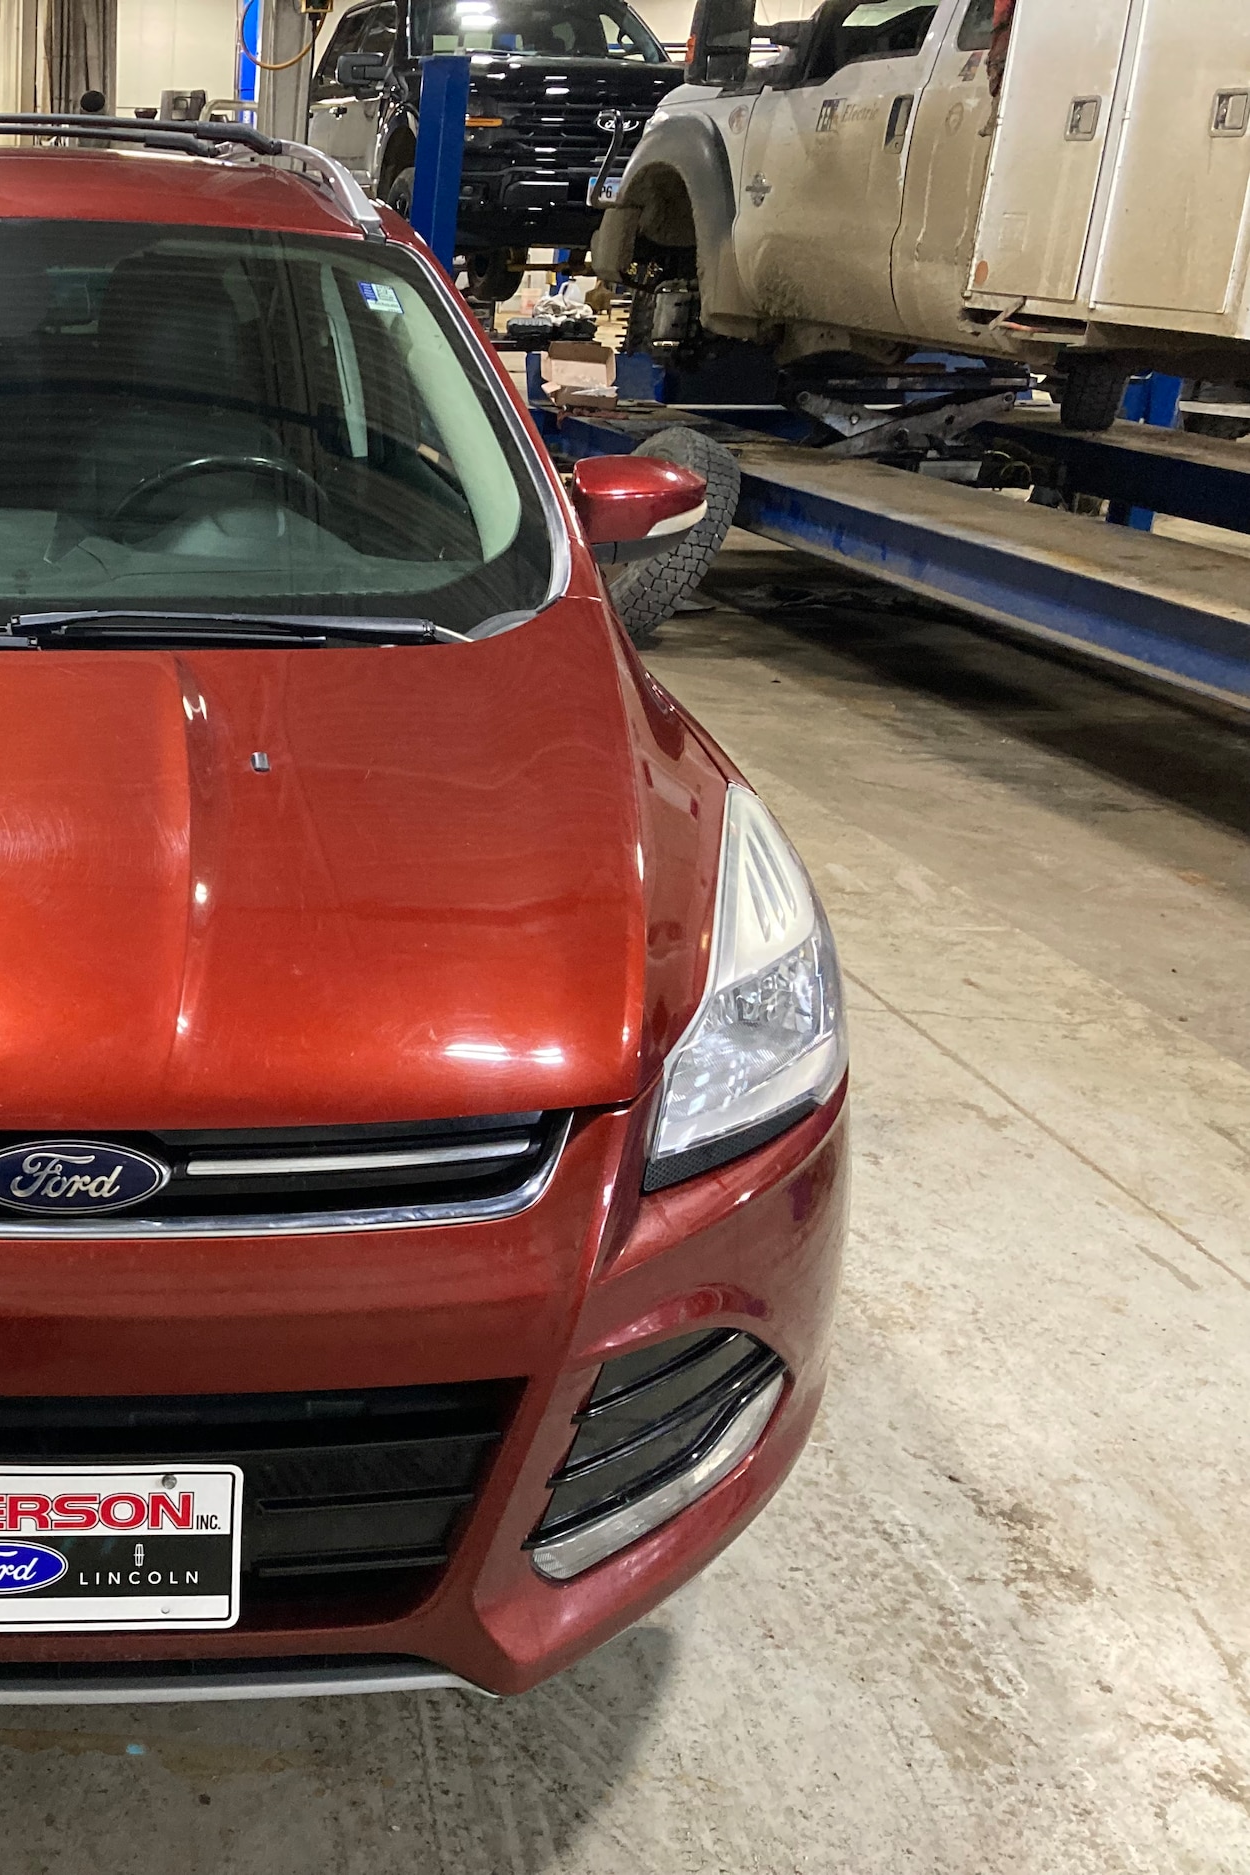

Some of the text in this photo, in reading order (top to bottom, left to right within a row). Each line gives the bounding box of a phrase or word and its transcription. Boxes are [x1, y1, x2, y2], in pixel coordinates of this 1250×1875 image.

[604, 119, 631, 129] Fod
[9, 1152, 124, 1198] Ford
[196, 1514, 221, 1531] INC.
[79, 1570, 200, 1586] LINCOLN
